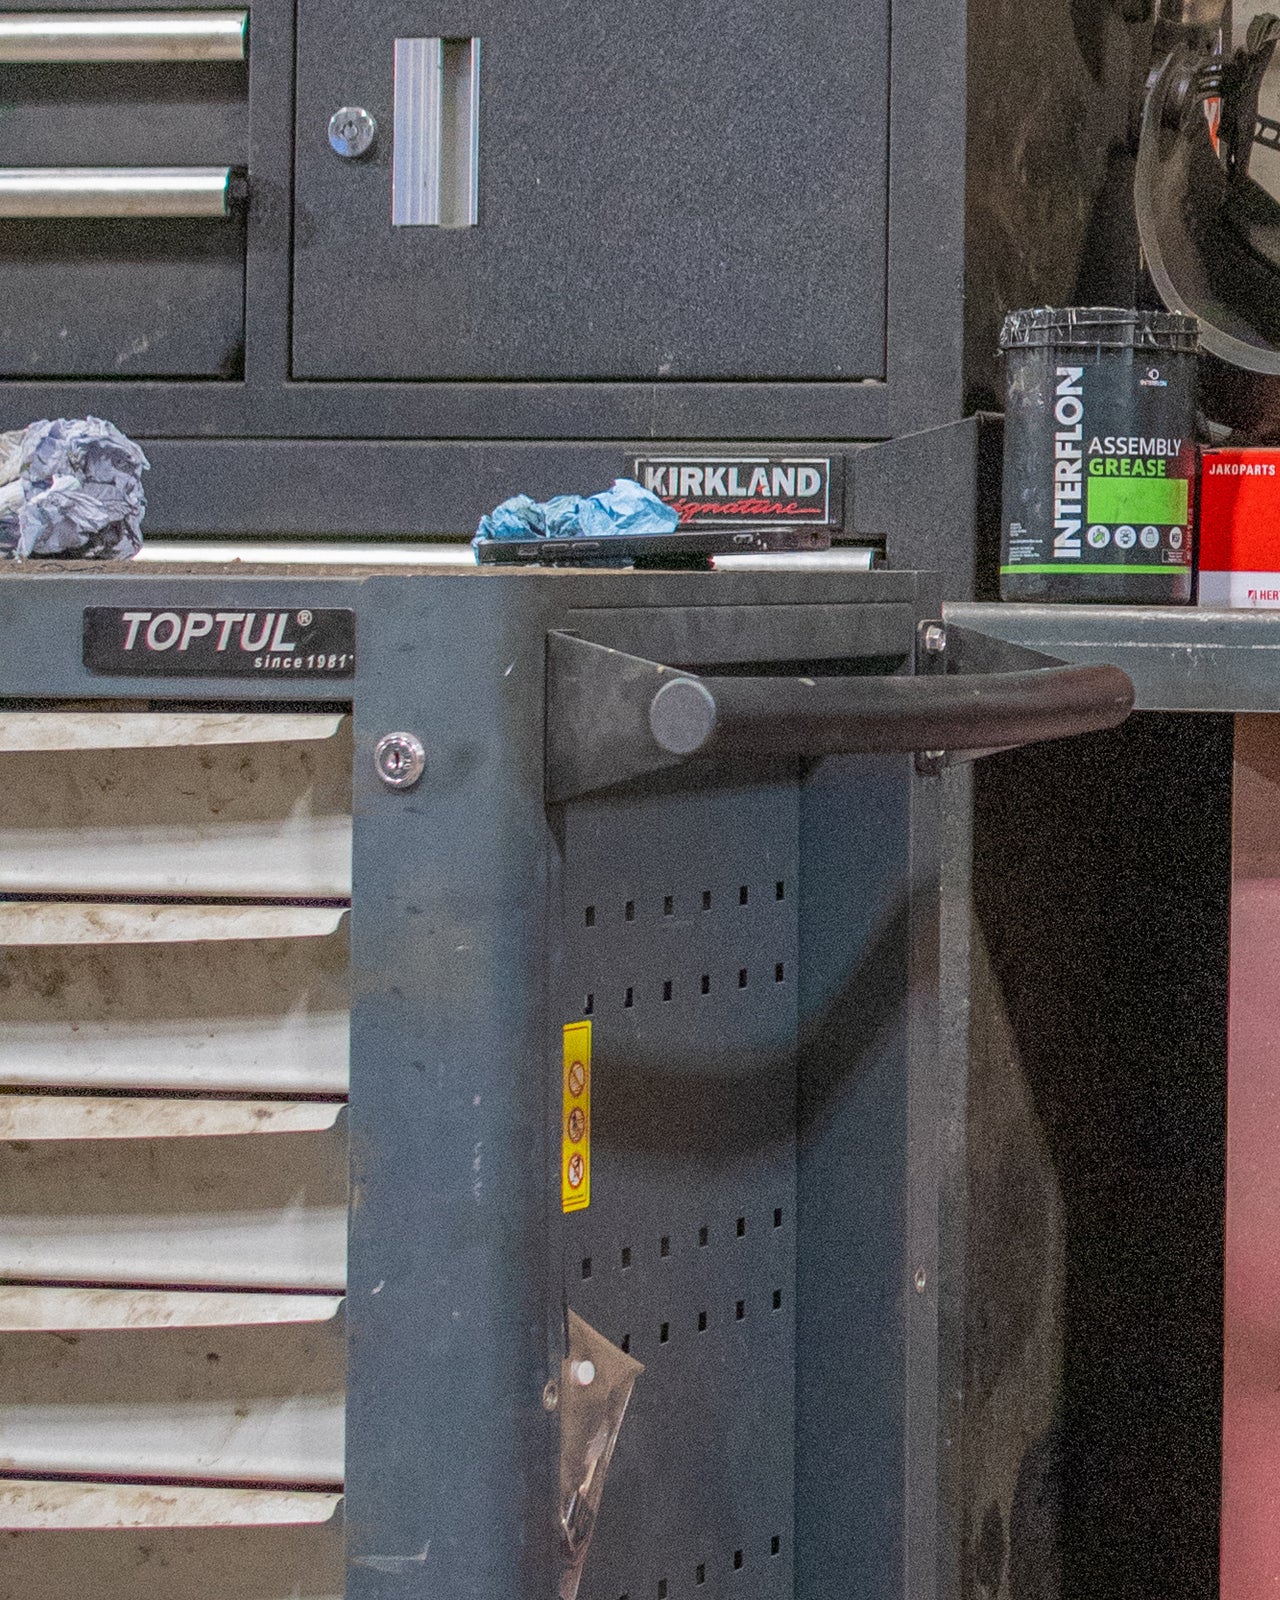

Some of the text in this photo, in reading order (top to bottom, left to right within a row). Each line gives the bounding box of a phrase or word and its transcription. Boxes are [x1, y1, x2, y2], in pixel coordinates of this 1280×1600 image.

[1088, 436, 1182, 457] ASSEMBLY
[1054, 366, 1084, 558] INTERFLON
[1089, 458, 1166, 477] GREASE
[1209, 463, 1276, 476] JAKOPARTS
[645, 466, 821, 497] KIRKLAND
[254, 655, 302, 668] since
